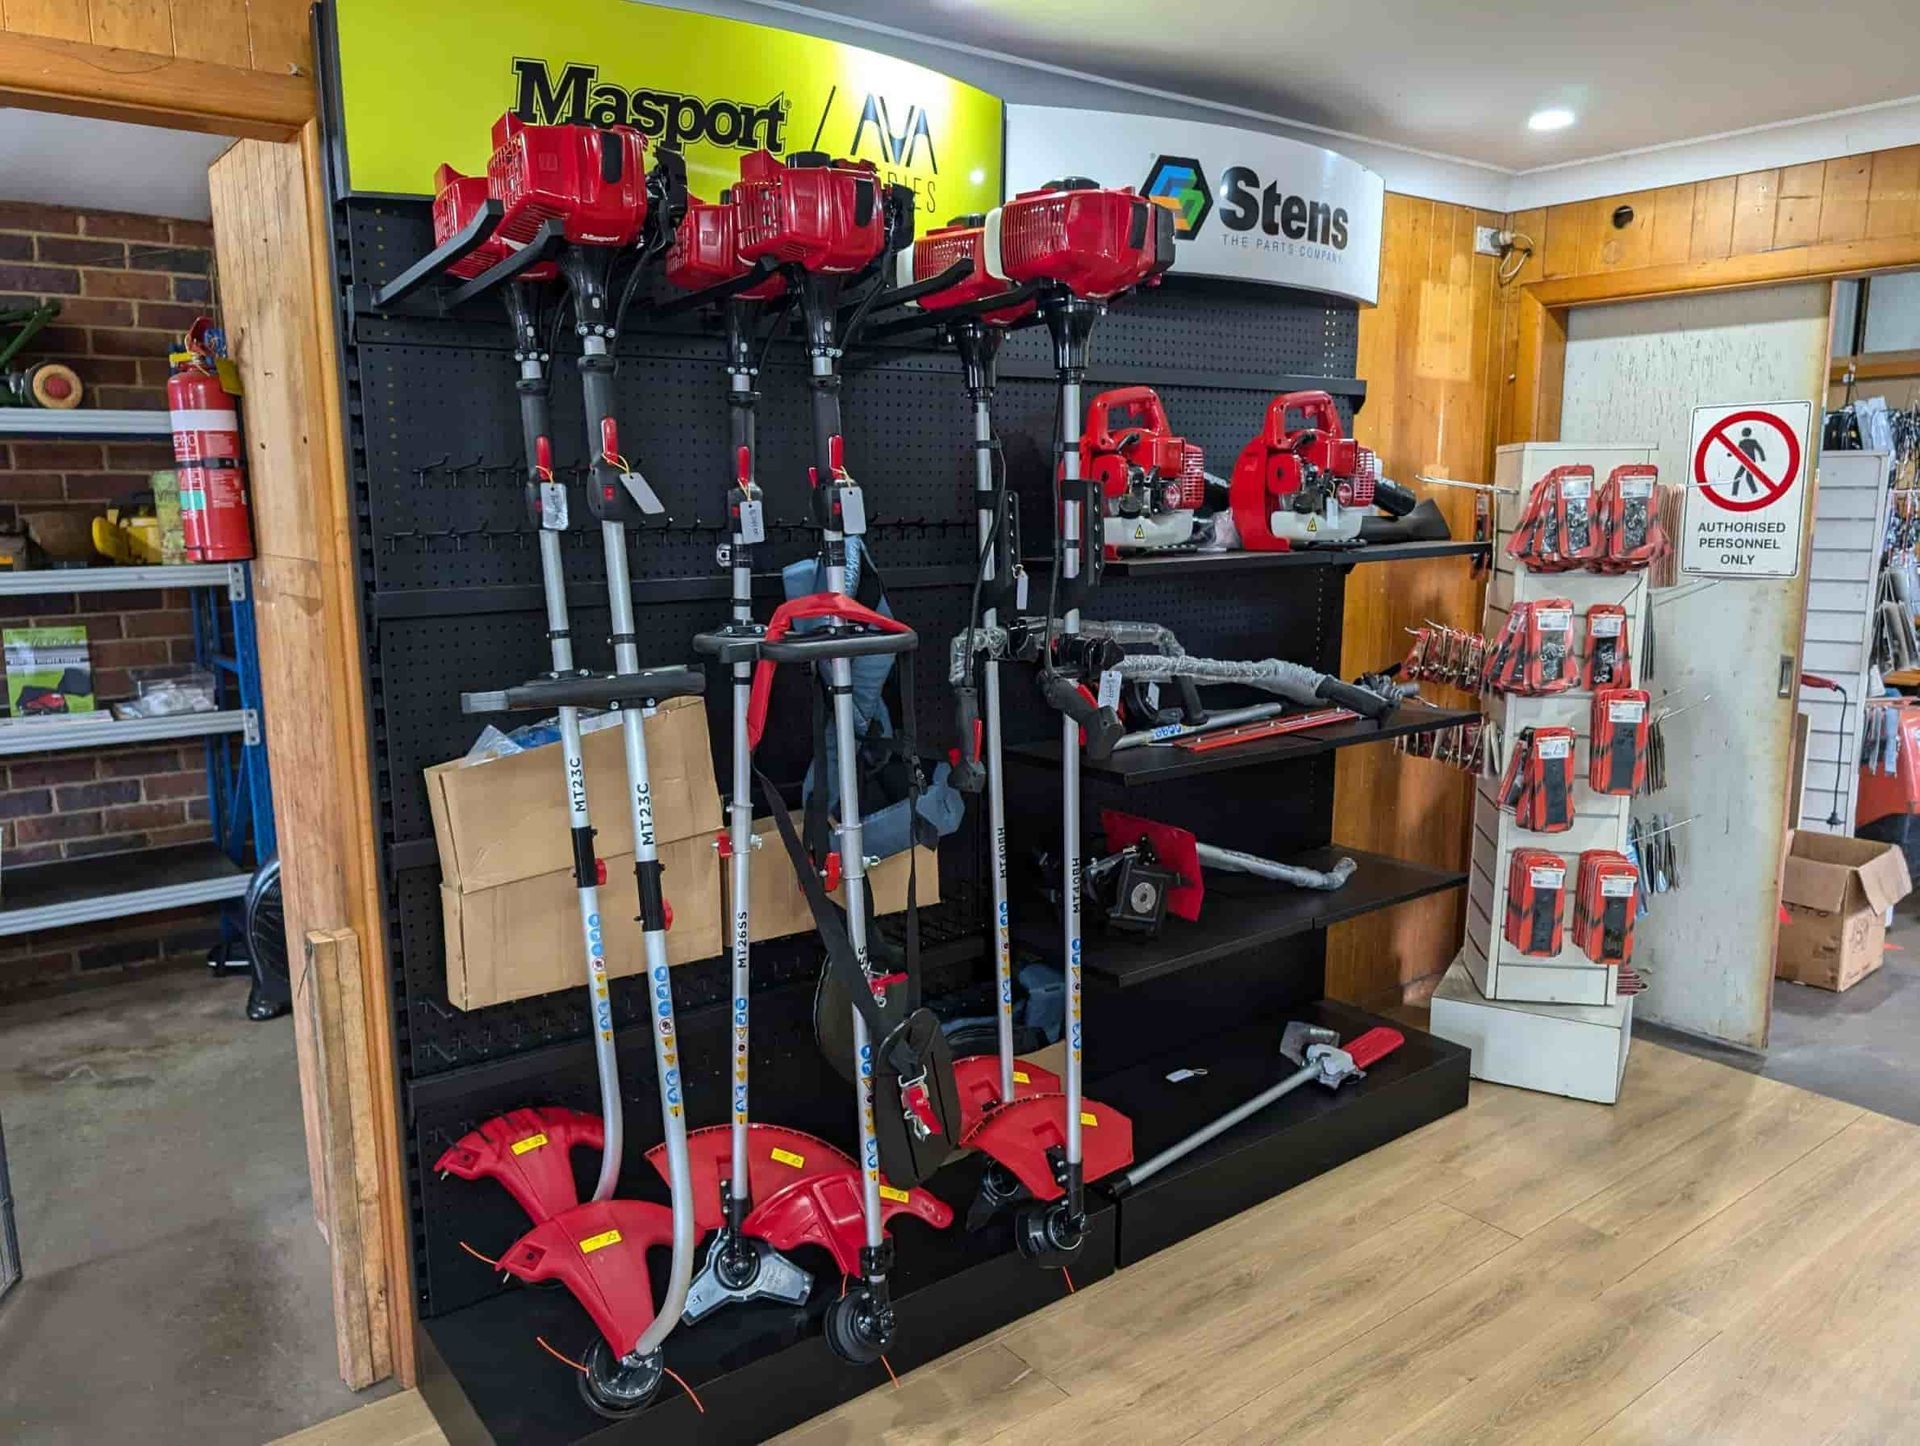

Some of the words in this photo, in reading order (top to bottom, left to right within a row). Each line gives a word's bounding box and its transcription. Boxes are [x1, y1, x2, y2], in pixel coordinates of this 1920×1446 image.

[512, 56, 787, 156] Masport
[1219, 166, 1349, 250] Stens
[1221, 233, 1249, 248] THE
[1256, 238, 1295, 255] PARTS
[1299, 245, 1343, 264] COMPANY
[1698, 522, 1786, 533] AUTHORISED
[1698, 538, 1781, 550] PERSONNEL
[1720, 554, 1756, 565] ONLY
[569, 757, 586, 812] MT23C
[637, 782, 654, 846] MT23C
[737, 911, 748, 968] MT26SS
